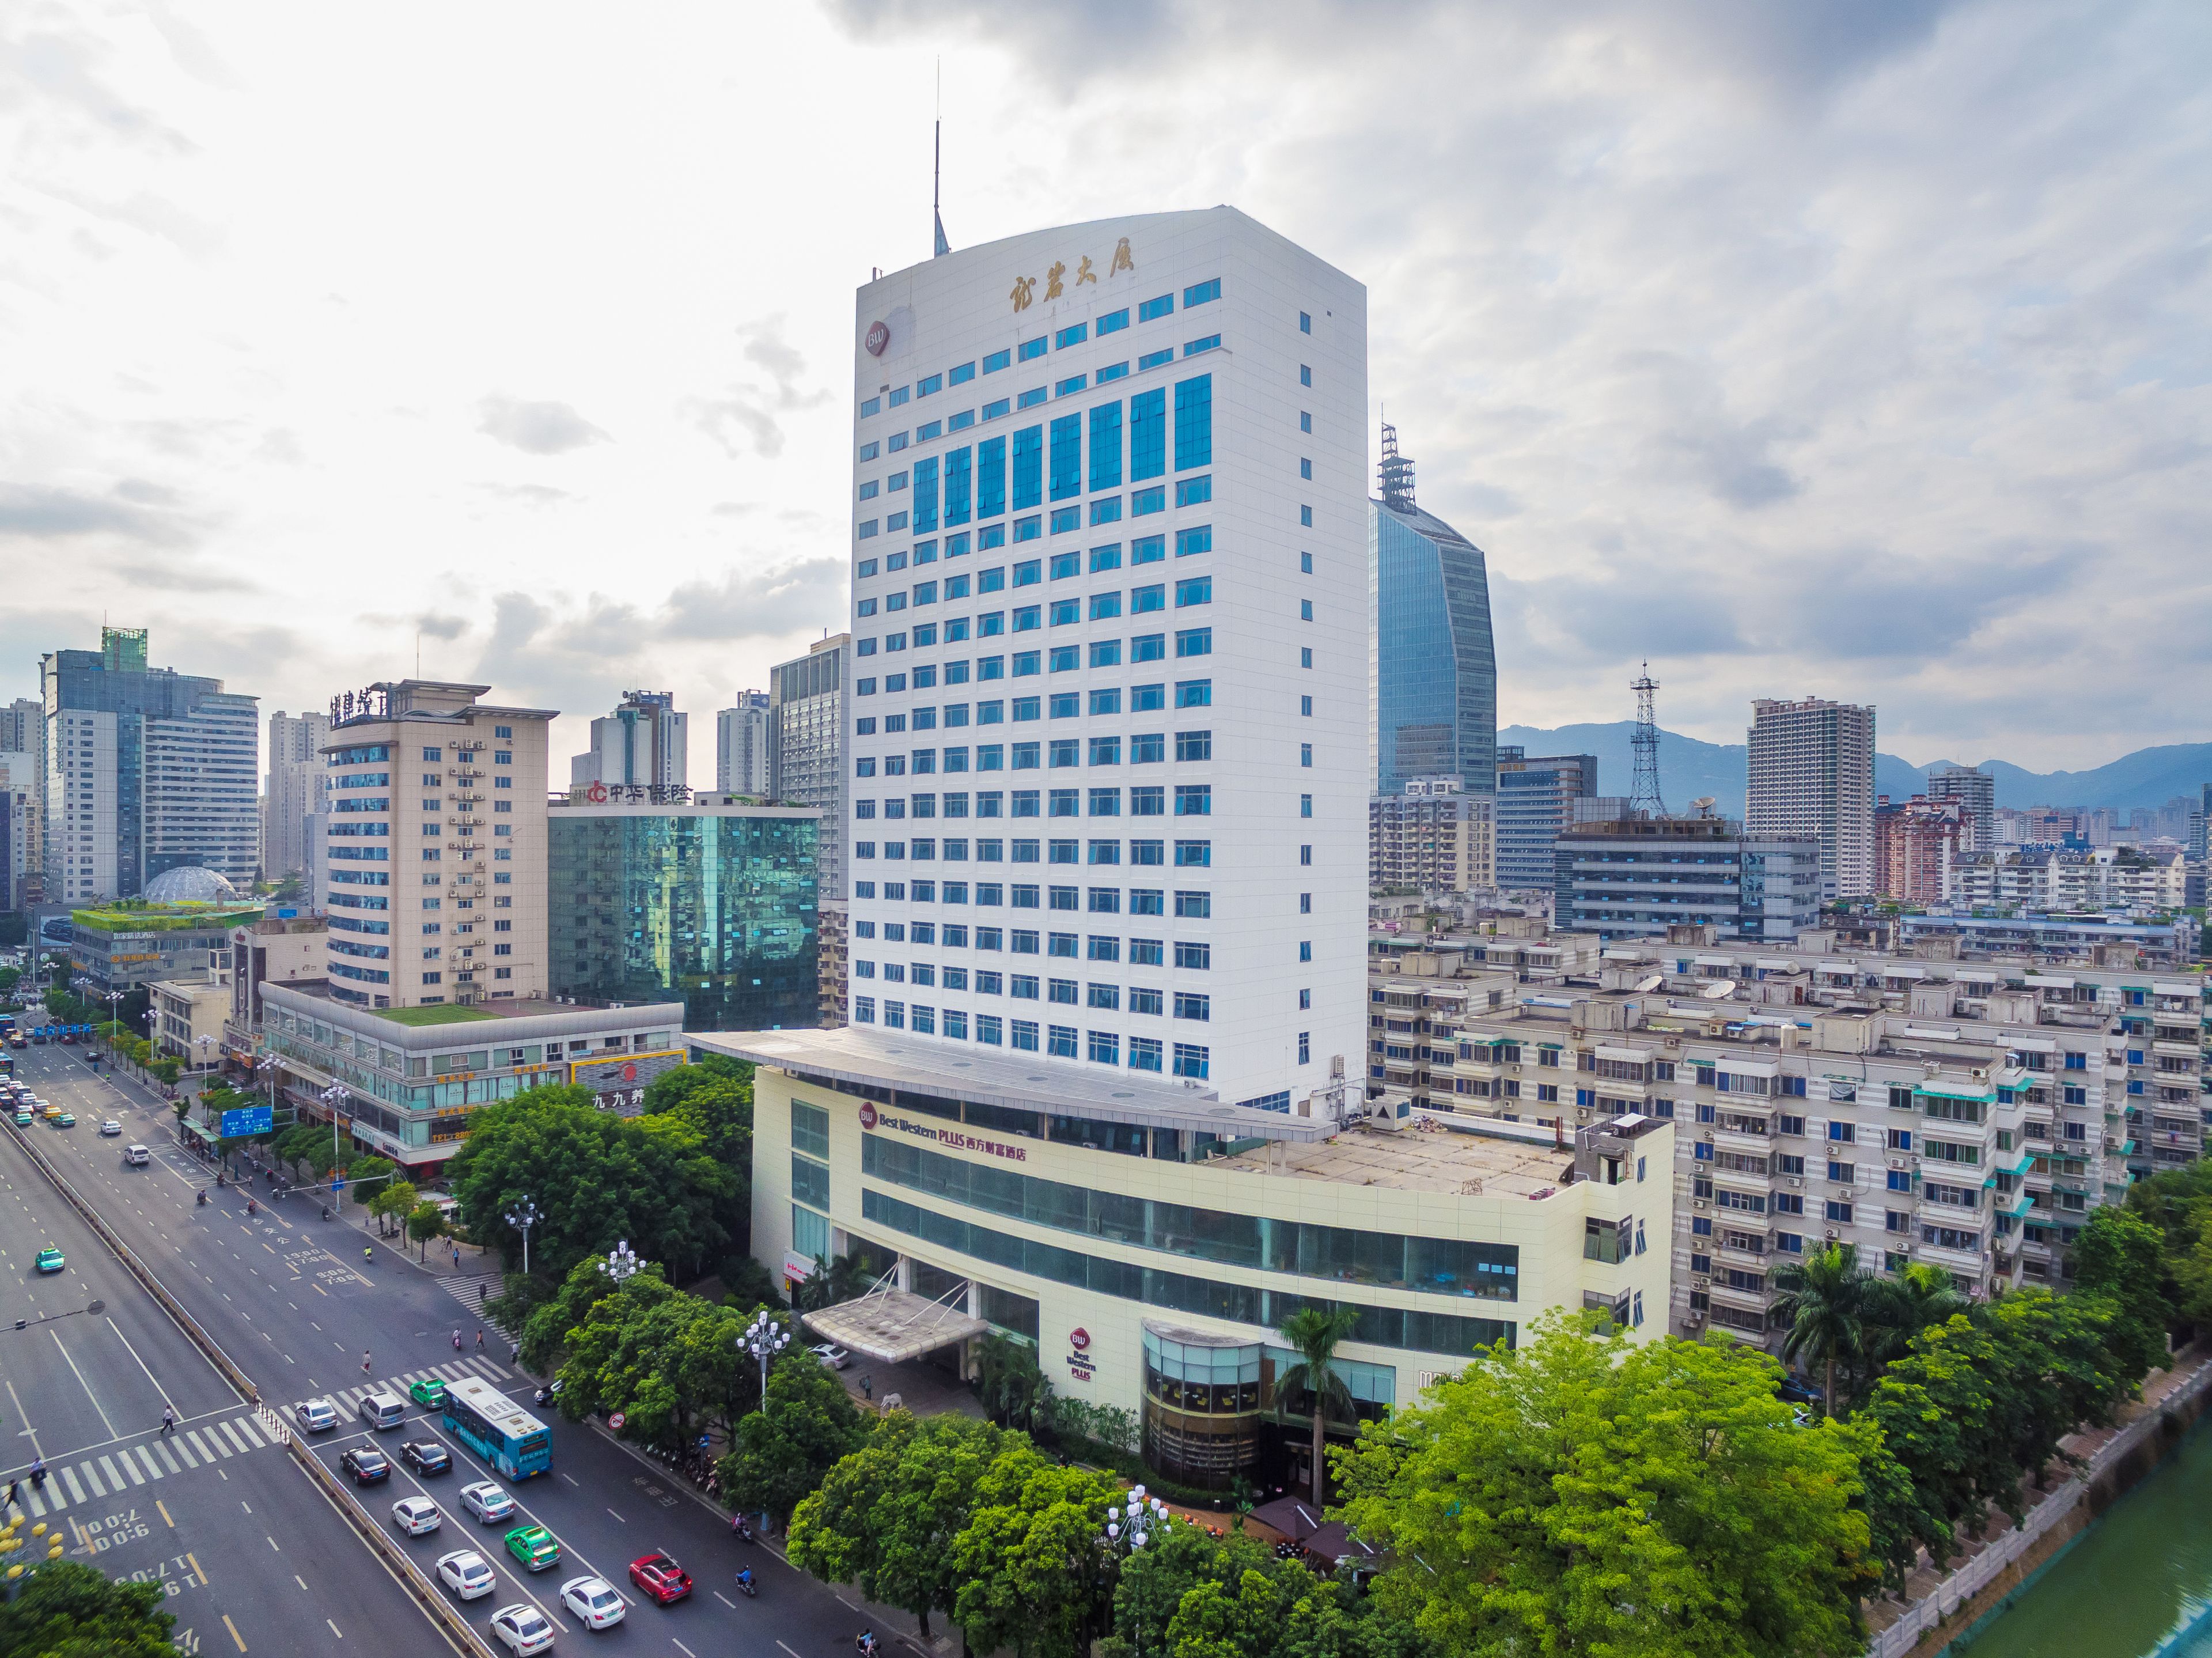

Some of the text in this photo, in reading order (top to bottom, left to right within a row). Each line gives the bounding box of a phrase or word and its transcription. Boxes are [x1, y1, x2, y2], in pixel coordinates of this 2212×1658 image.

[869, 329, 884, 347] BW
[611, 784, 694, 802] 中华保险
[861, 1110, 873, 1122] BW
[880, 1114, 1026, 1161] Best Western PLUS 西方财富酒店
[282, 1248, 320, 1260] 19:00
[291, 1255, 328, 1266] 17:00
[316, 1268, 346, 1278] 9:00
[324, 1274, 356, 1285] 7:00
[1072, 1334, 1085, 1345] BW
[1074, 1350, 1089, 1362] Best
[1067, 1356, 1096, 1372] Western
[1071, 1367, 1090, 1380] PLUS
